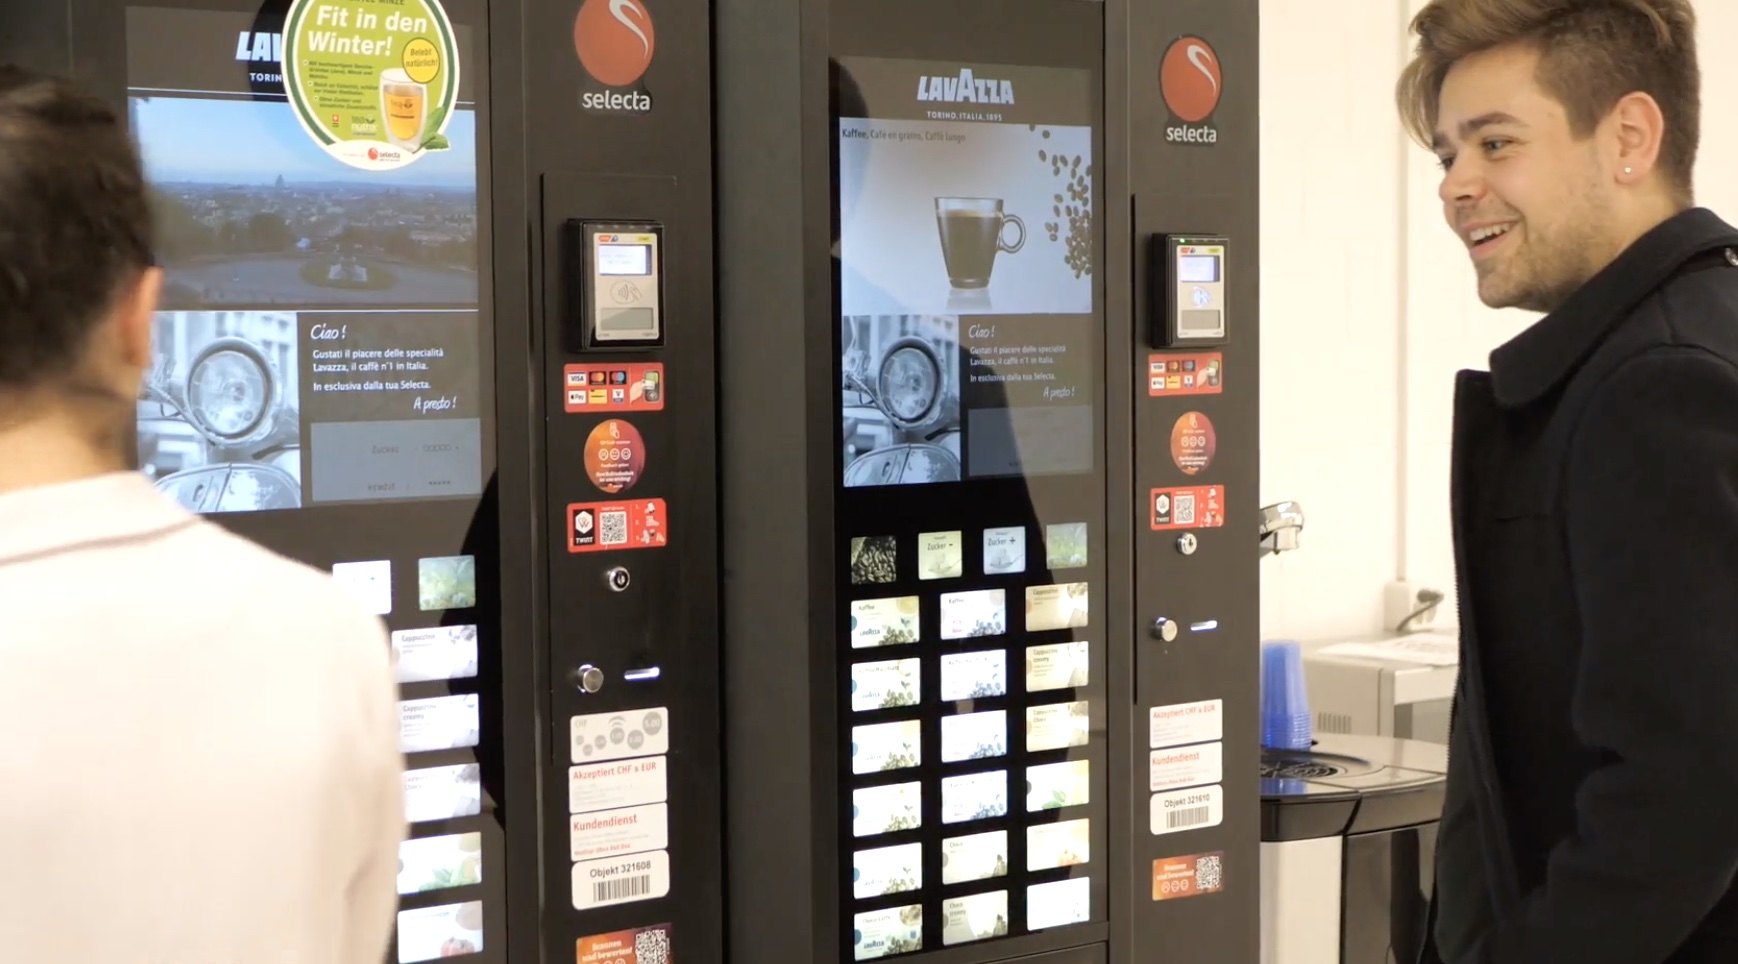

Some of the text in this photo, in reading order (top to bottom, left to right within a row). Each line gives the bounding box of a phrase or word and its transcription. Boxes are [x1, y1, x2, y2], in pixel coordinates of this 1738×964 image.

[317, 5, 428, 34] Fit in den
[308, 31, 393, 56] Winter!
[917, 68, 1015, 104] LAVAZZA
[582, 90, 651, 111] selecta
[842, 128, 869, 139] Kaffee,
[946, 132, 966, 144] lungo
[1166, 124, 1217, 143] selecta
[313, 347, 444, 362] Gustati il piacere delle specialità
[970, 344, 1066, 356] Gustati il piacere delle specialità
[313, 363, 349, 373] Lavazza,
[351, 363, 357, 371] il
[396, 362, 405, 370] in
[406, 361, 429, 370] Italia.
[978, 374, 1005, 382] esclusiva
[313, 381, 432, 391] In esclusiva dalla tua Selecta.
[927, 542, 947, 551] Zucker
[988, 538, 1007, 546] Zucker
[401, 634, 436, 644] Cappuccino
[1153, 709, 1184, 721] Akzeptiert
[1204, 704, 1215, 713] EUR
[1152, 752, 1200, 766] Kundendienst
[574, 767, 615, 782] Akzeptiert
[617, 764, 632, 775] CHF
[642, 762, 657, 772] EUR
[1164, 794, 1210, 809] Objekt 321610
[574, 814, 637, 831] Kundendienst
[590, 861, 651, 878] Objekt 321608
